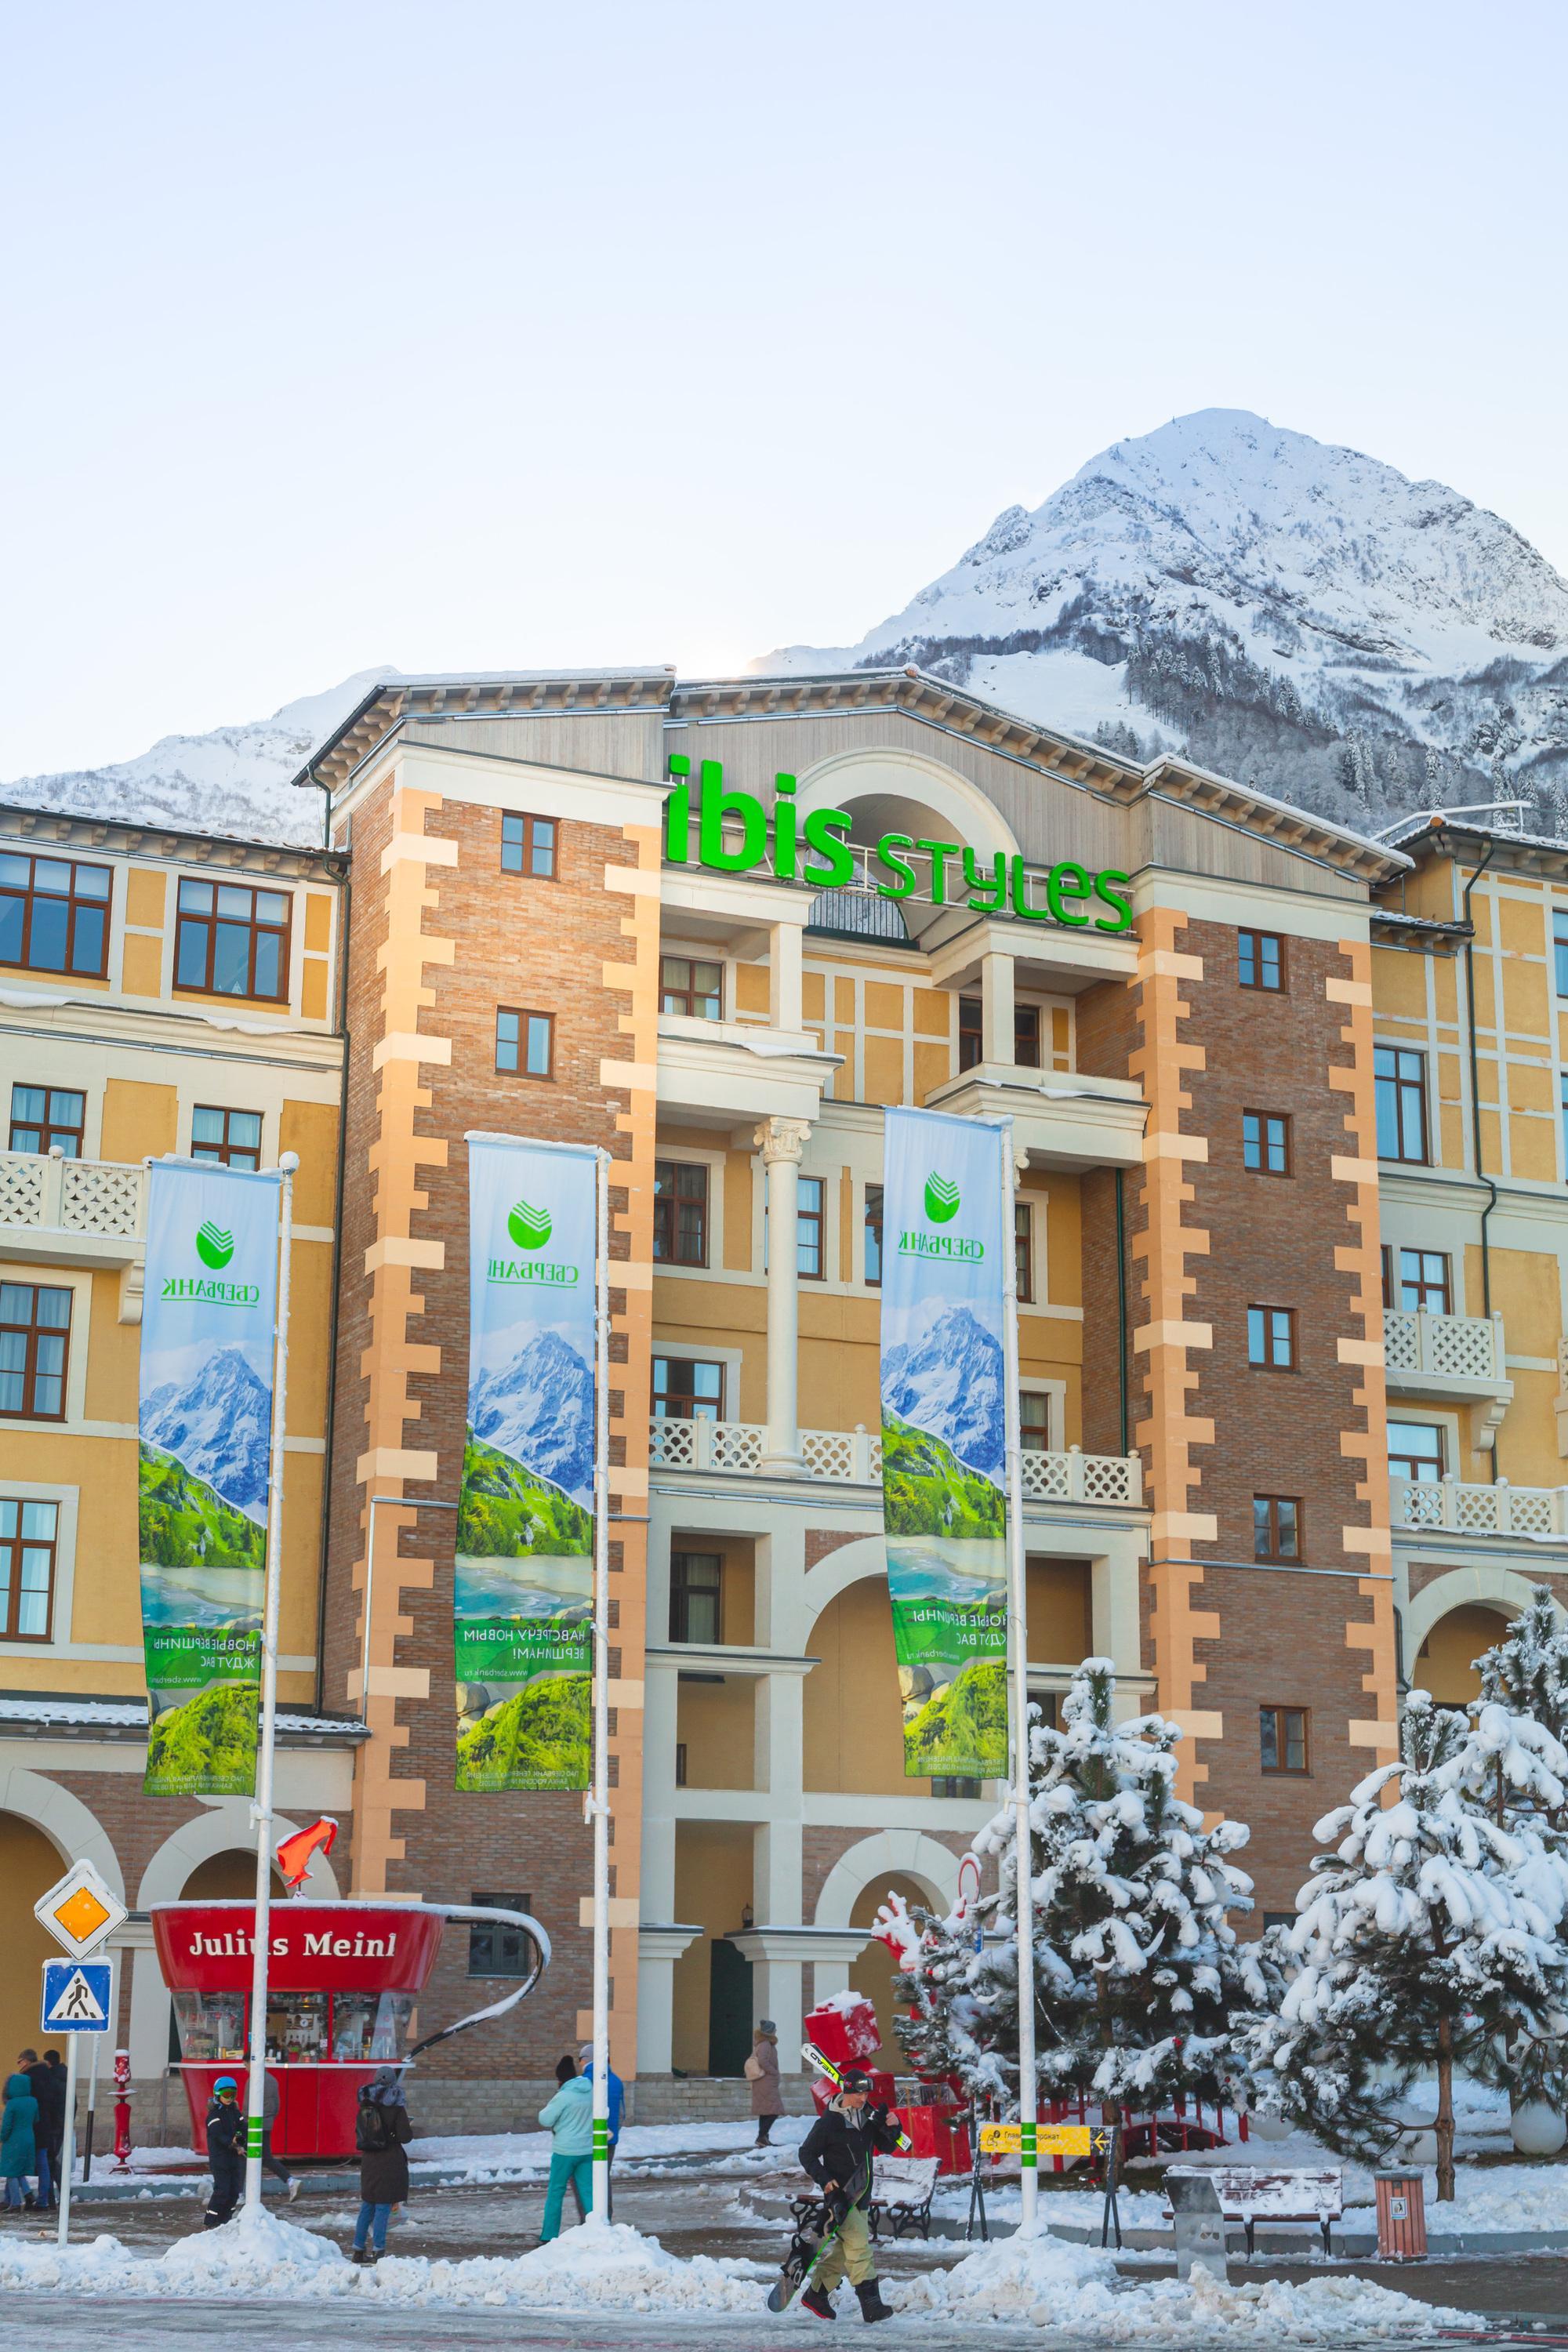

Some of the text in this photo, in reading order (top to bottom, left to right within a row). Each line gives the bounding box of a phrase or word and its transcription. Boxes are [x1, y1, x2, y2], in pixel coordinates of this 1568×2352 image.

[666, 753, 854, 887] ibis
[189, 1929, 397, 1957] Julis Meinl
[810, 2053, 836, 2078] HEAD
